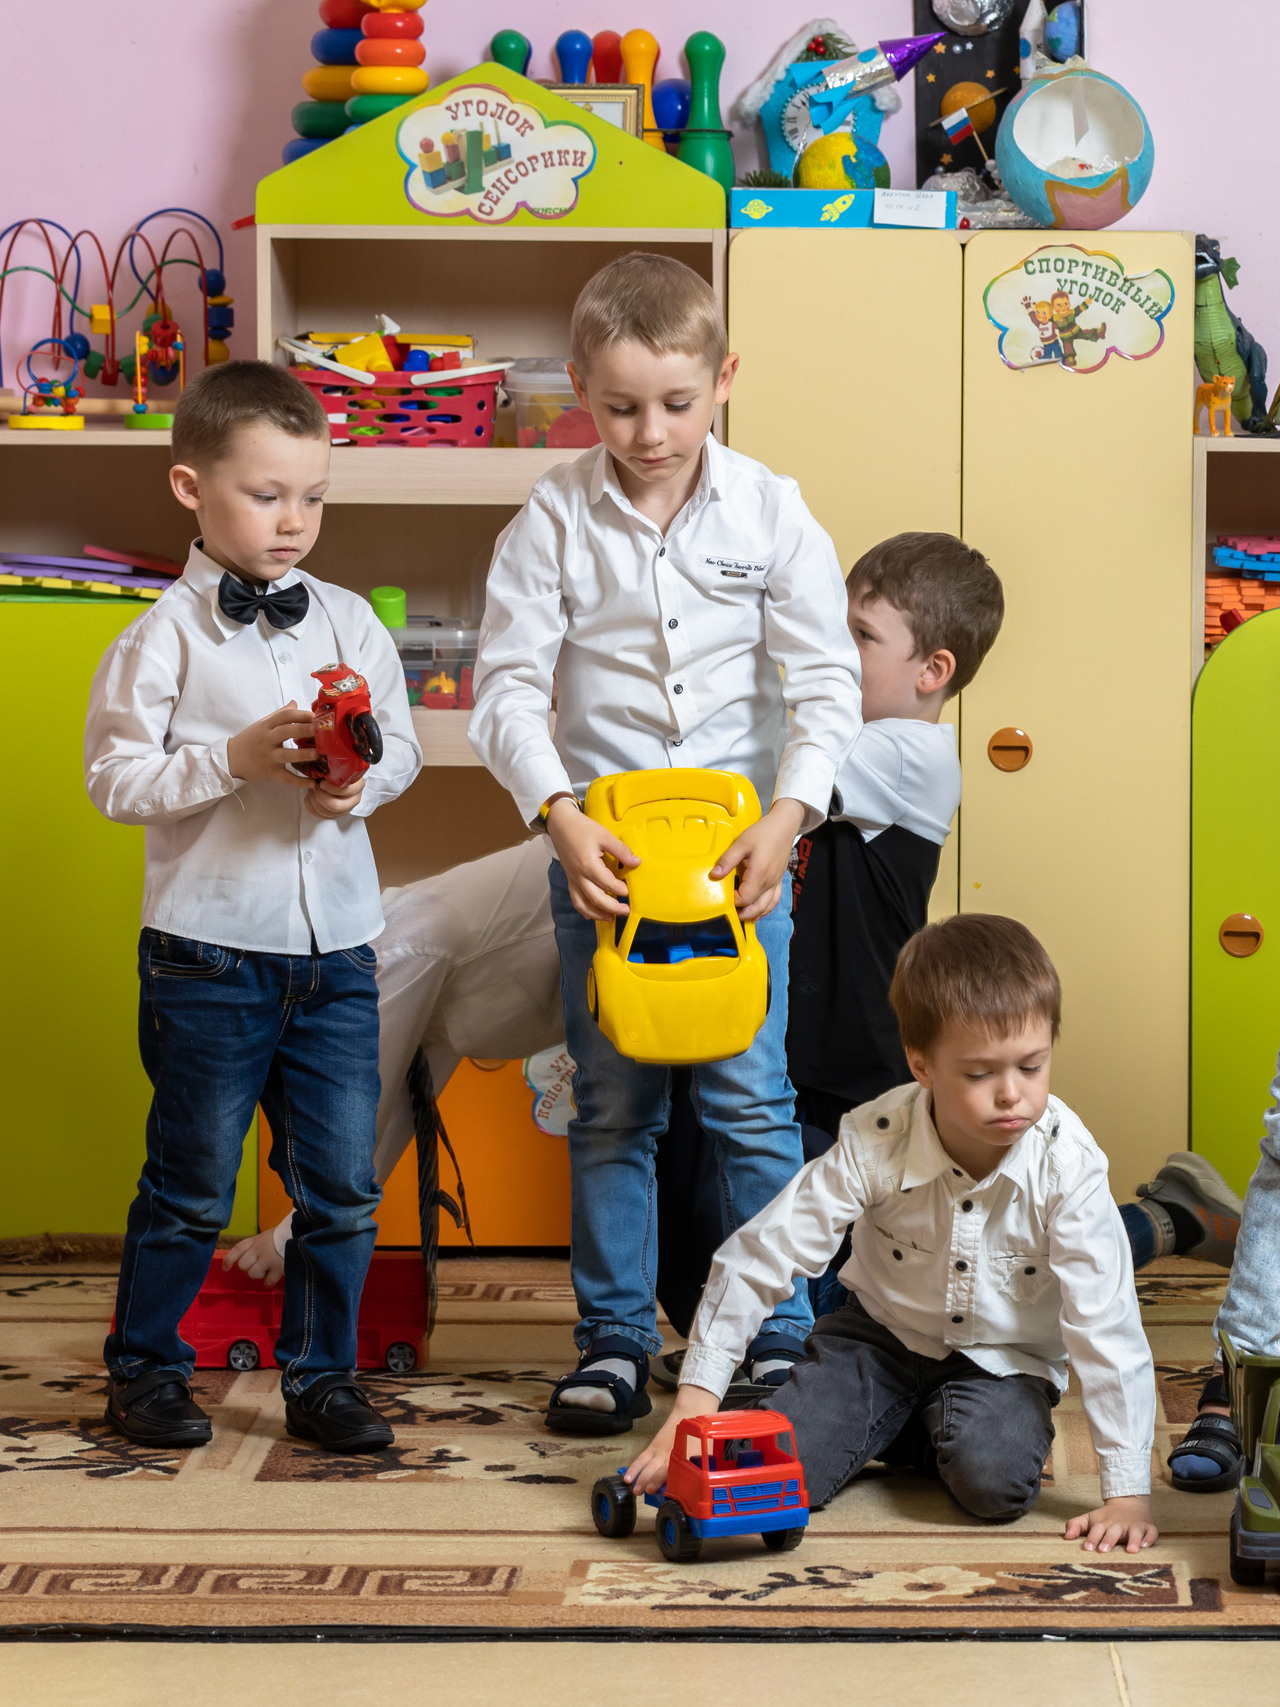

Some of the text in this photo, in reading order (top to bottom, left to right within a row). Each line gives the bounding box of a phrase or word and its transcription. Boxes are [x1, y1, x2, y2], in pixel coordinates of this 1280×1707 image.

[445, 99, 535, 138] УГОЛОК
[477, 149, 587, 217] СЕНСОРИКИ
[1024, 257, 1165, 320] СПОРТИВНЫЙ
[1056, 278, 1127, 315] УГОЛОК
[537, 1065, 577, 1120] КОНСТР
